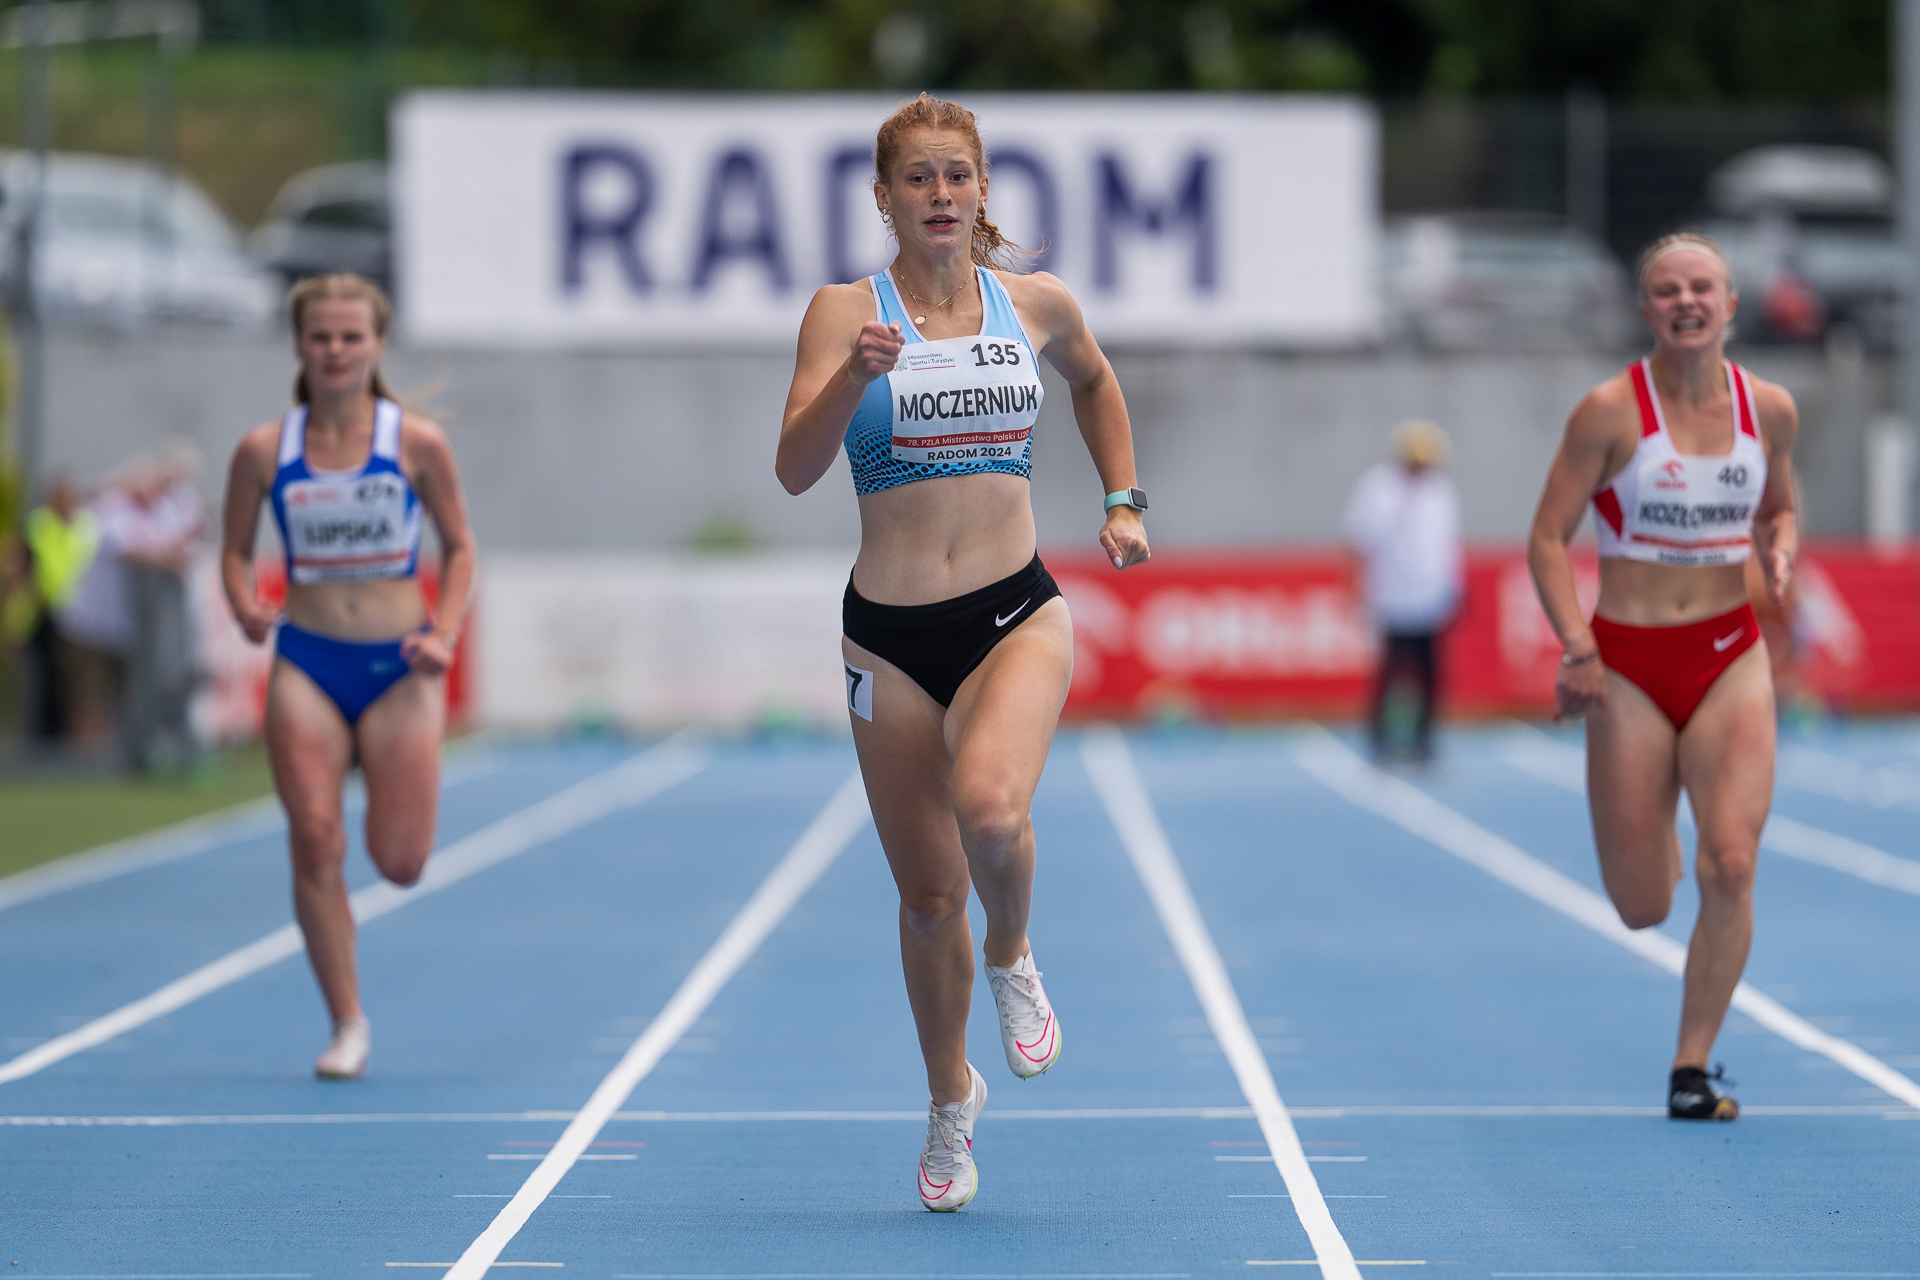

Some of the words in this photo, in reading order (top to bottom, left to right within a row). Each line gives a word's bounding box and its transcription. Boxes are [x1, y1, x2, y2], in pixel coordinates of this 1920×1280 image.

[970, 343, 1020, 367] 135
[899, 385, 1037, 422] MOCZERNIUK
[907, 439, 920, 447] 78.
[942, 434, 992, 444] Mistrzostwa
[993, 432, 1016, 442] Polski
[1017, 429, 1030, 440] U20
[927, 449, 978, 461] RADOM
[980, 446, 1012, 457] 2024
[1718, 464, 1748, 487] 40
[1638, 501, 1751, 529] KOZŁOWSKA
[304, 517, 393, 547] LIPSKA
[846, 665, 862, 709] 7
